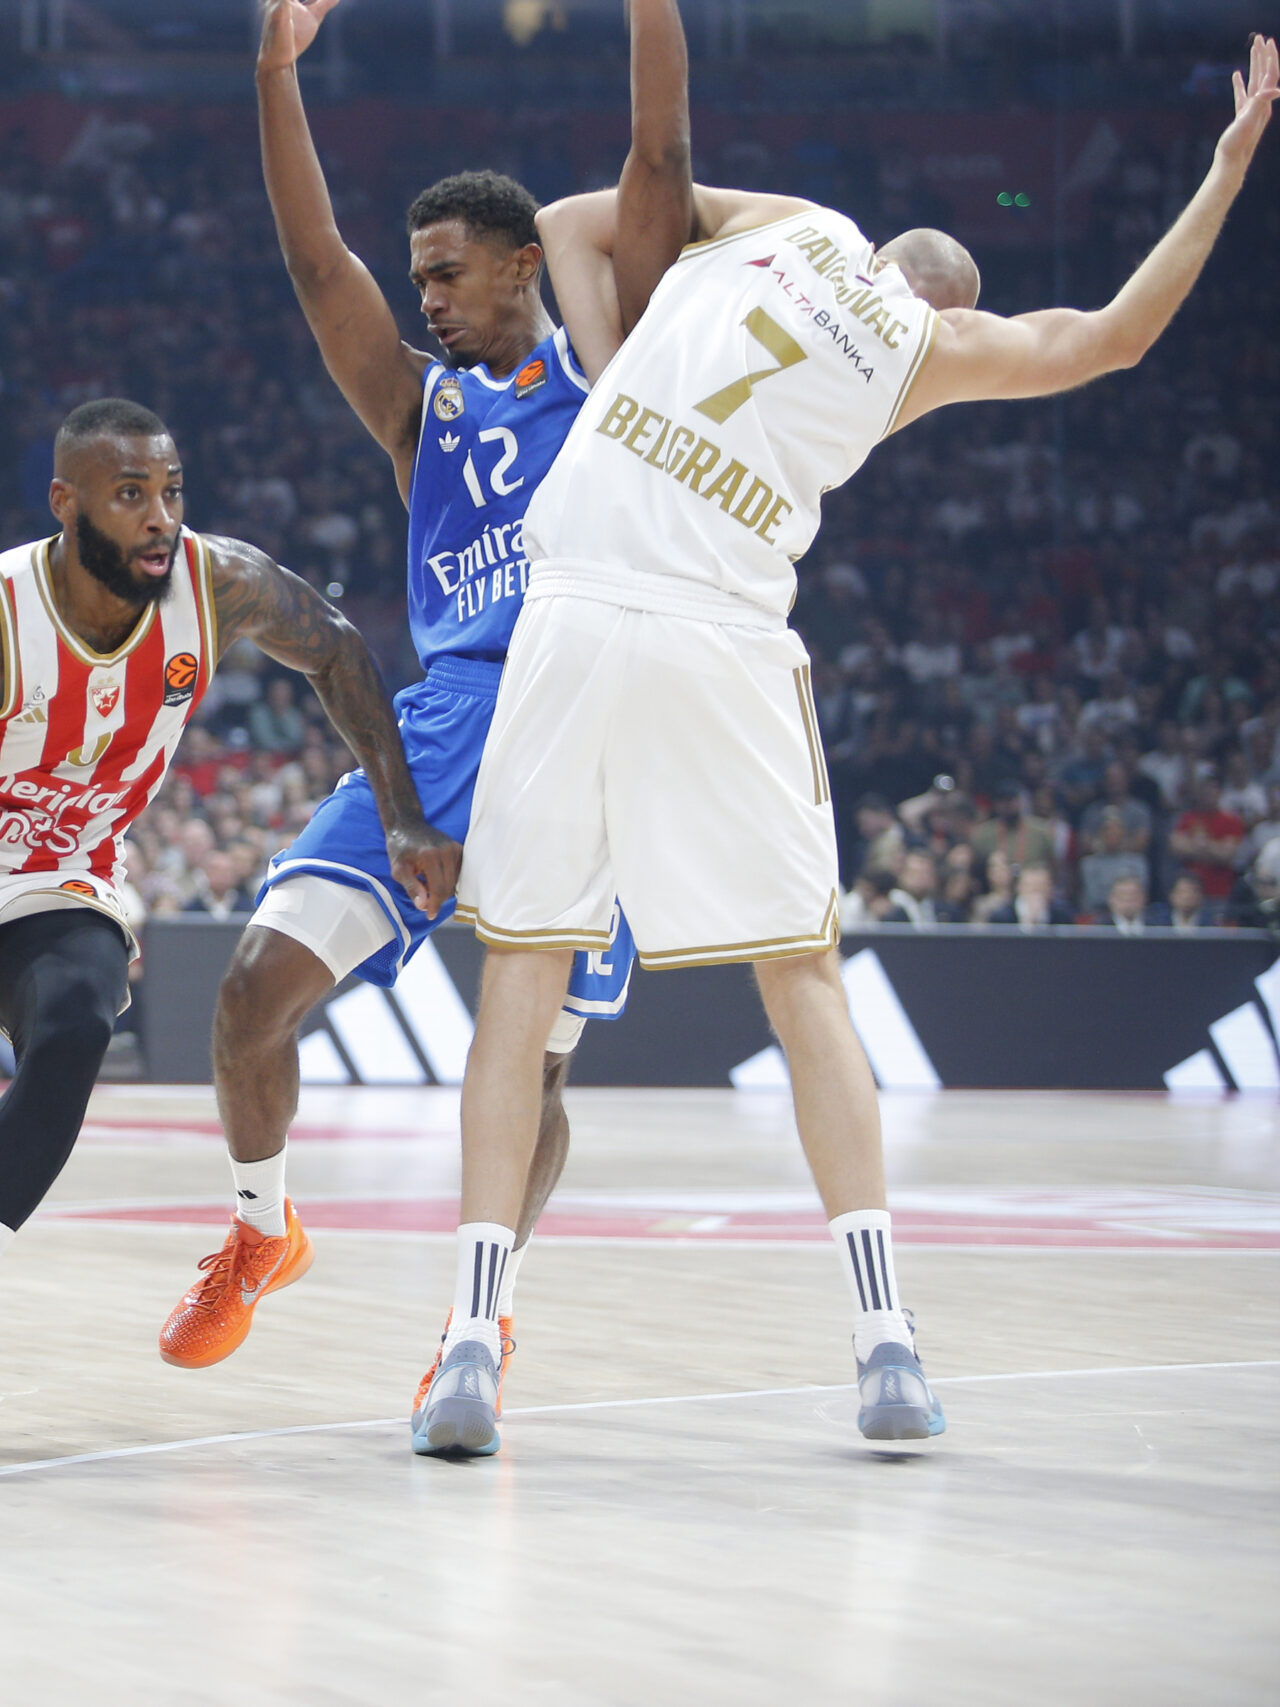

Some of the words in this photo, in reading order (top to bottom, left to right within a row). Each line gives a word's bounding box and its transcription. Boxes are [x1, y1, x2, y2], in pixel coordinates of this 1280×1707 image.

[692, 306, 809, 426] 7
[462, 426, 525, 508] 12
[595, 393, 794, 546] BELGRADE
[426, 518, 526, 596] Emira
[457, 575, 488, 623] FLY
[491, 558, 529, 605] BET
